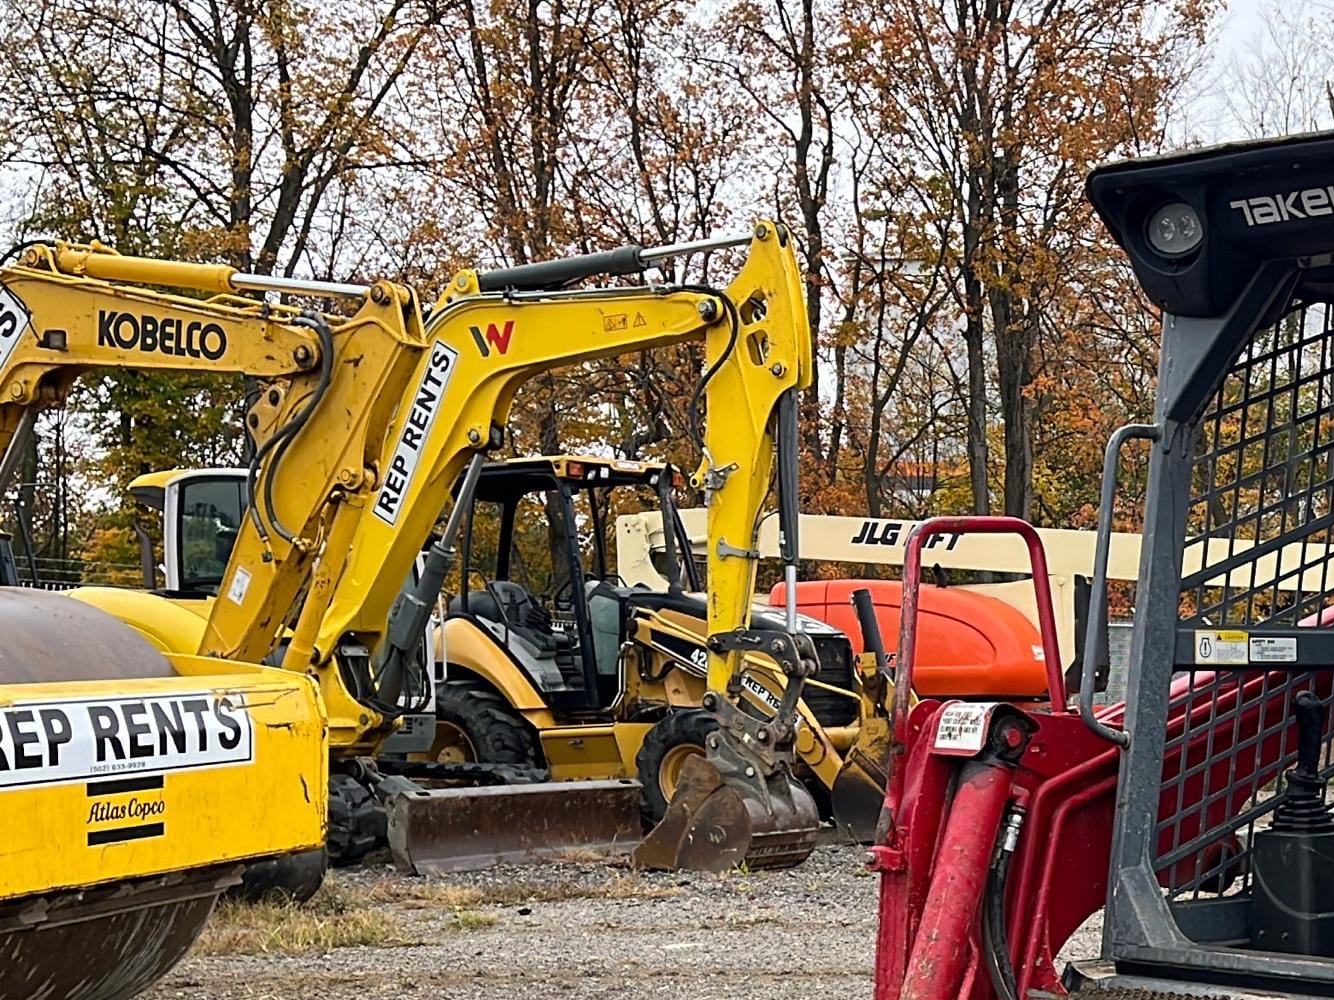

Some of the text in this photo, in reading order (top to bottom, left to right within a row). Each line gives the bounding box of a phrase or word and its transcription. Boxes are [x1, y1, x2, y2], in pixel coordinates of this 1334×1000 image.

[98, 310, 227, 360] KOBELCO
[378, 350, 450, 515] REP RENTS
[851, 521, 964, 551] JLG FT
[690, 648, 707, 669] 42
[744, 676, 766, 695] REP
[87, 697, 242, 763] RENTS
[86, 797, 165, 825] Atlas Copco
